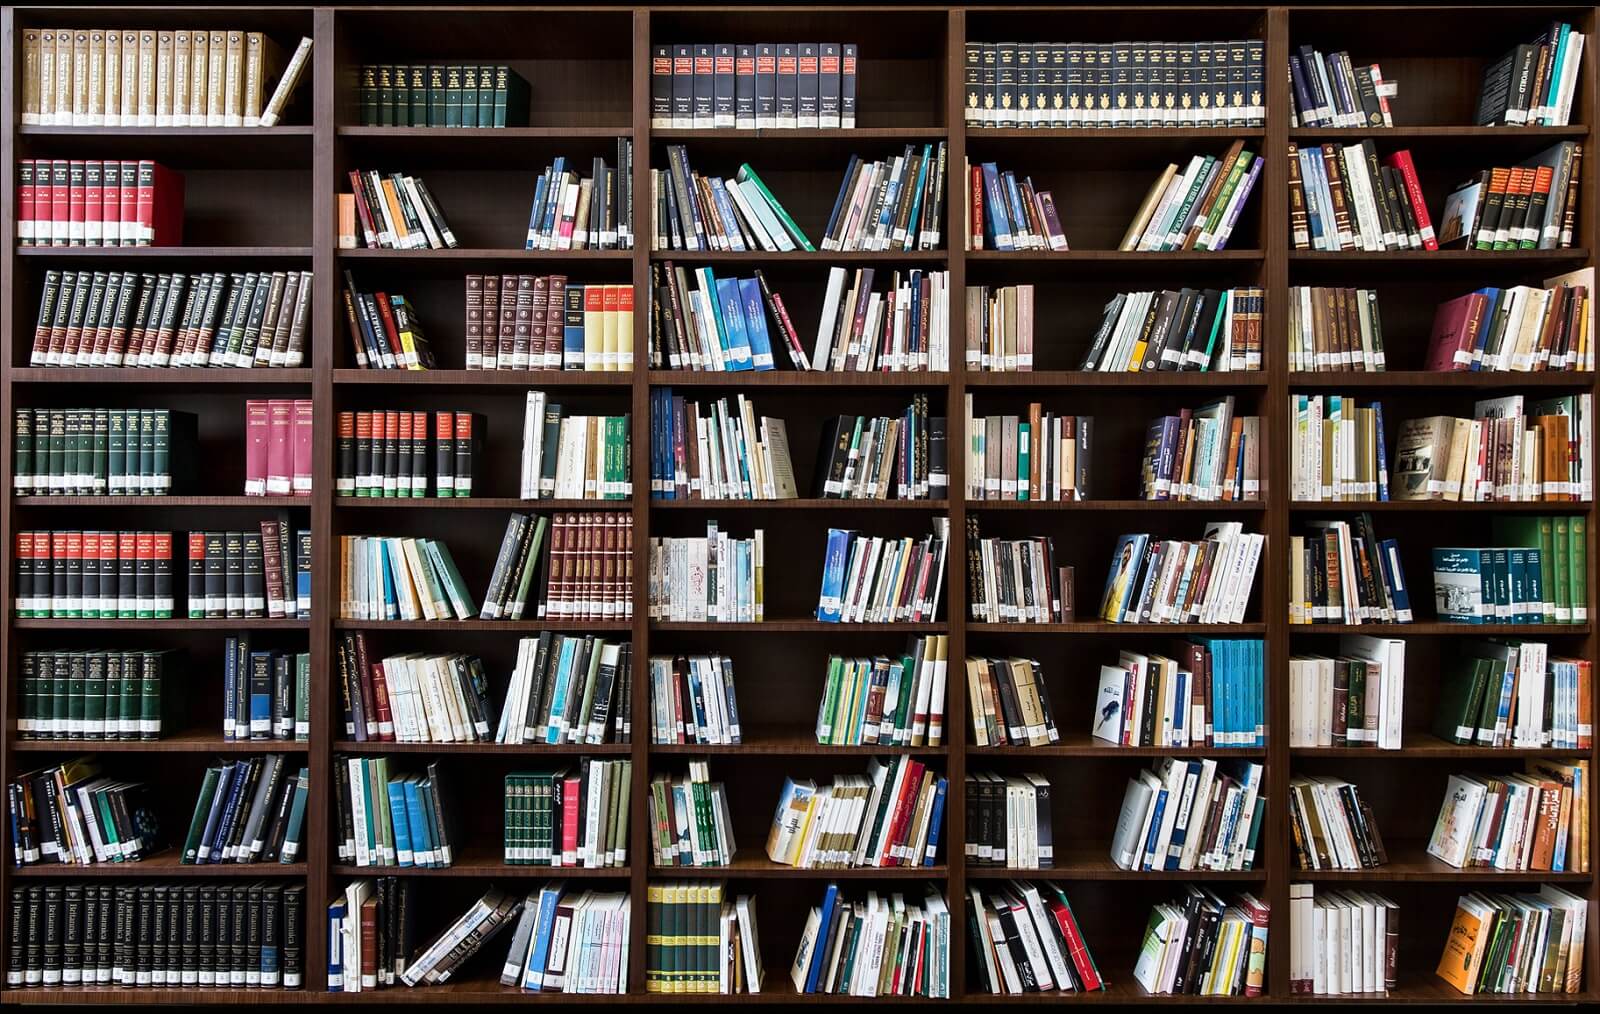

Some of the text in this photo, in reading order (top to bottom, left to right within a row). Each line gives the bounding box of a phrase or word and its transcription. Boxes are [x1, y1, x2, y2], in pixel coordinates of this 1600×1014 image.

[1517, 69, 1529, 93] WORLD
[871, 179, 888, 228] DUBAI CITY
[1171, 161, 1211, 234] BEFORE THEIR DIASPORA
[42, 287, 55, 323] Britannica
[58, 288, 72, 323] Britannica
[73, 288, 86, 323] Britannica
[88, 288, 102, 323] Britannica
[103, 288, 116, 324] Britannica
[118, 289, 131, 324] Britannica
[136, 290, 150, 325] Britannica
[151, 291, 165, 325] Britannica
[165, 289, 179, 324] Britannica
[182, 291, 196, 325] Britannica
[193, 290, 207, 325] Britannica
[206, 289, 220, 324] Britannica
[224, 290, 238, 325] Britannica
[236, 289, 252, 324] Britannica
[279, 520, 289, 543] ZAYED
[13, 906, 21, 942] Britannica
[29, 904, 38, 941] Britannica
[48, 904, 56, 941] Britannica
[69, 903, 77, 940] Britannica
[86, 903, 95, 940] Britannica
[101, 903, 109, 940] Britannica
[117, 903, 125, 939] Britannica
[125, 905, 133, 941] Britannica
[141, 904, 149, 941] Britannica
[156, 905, 164, 941] Britannica
[203, 905, 211, 941] Britannica
[235, 905, 243, 941] Britannica
[266, 905, 274, 941] Britannica
[288, 908, 296, 944] Britannica
